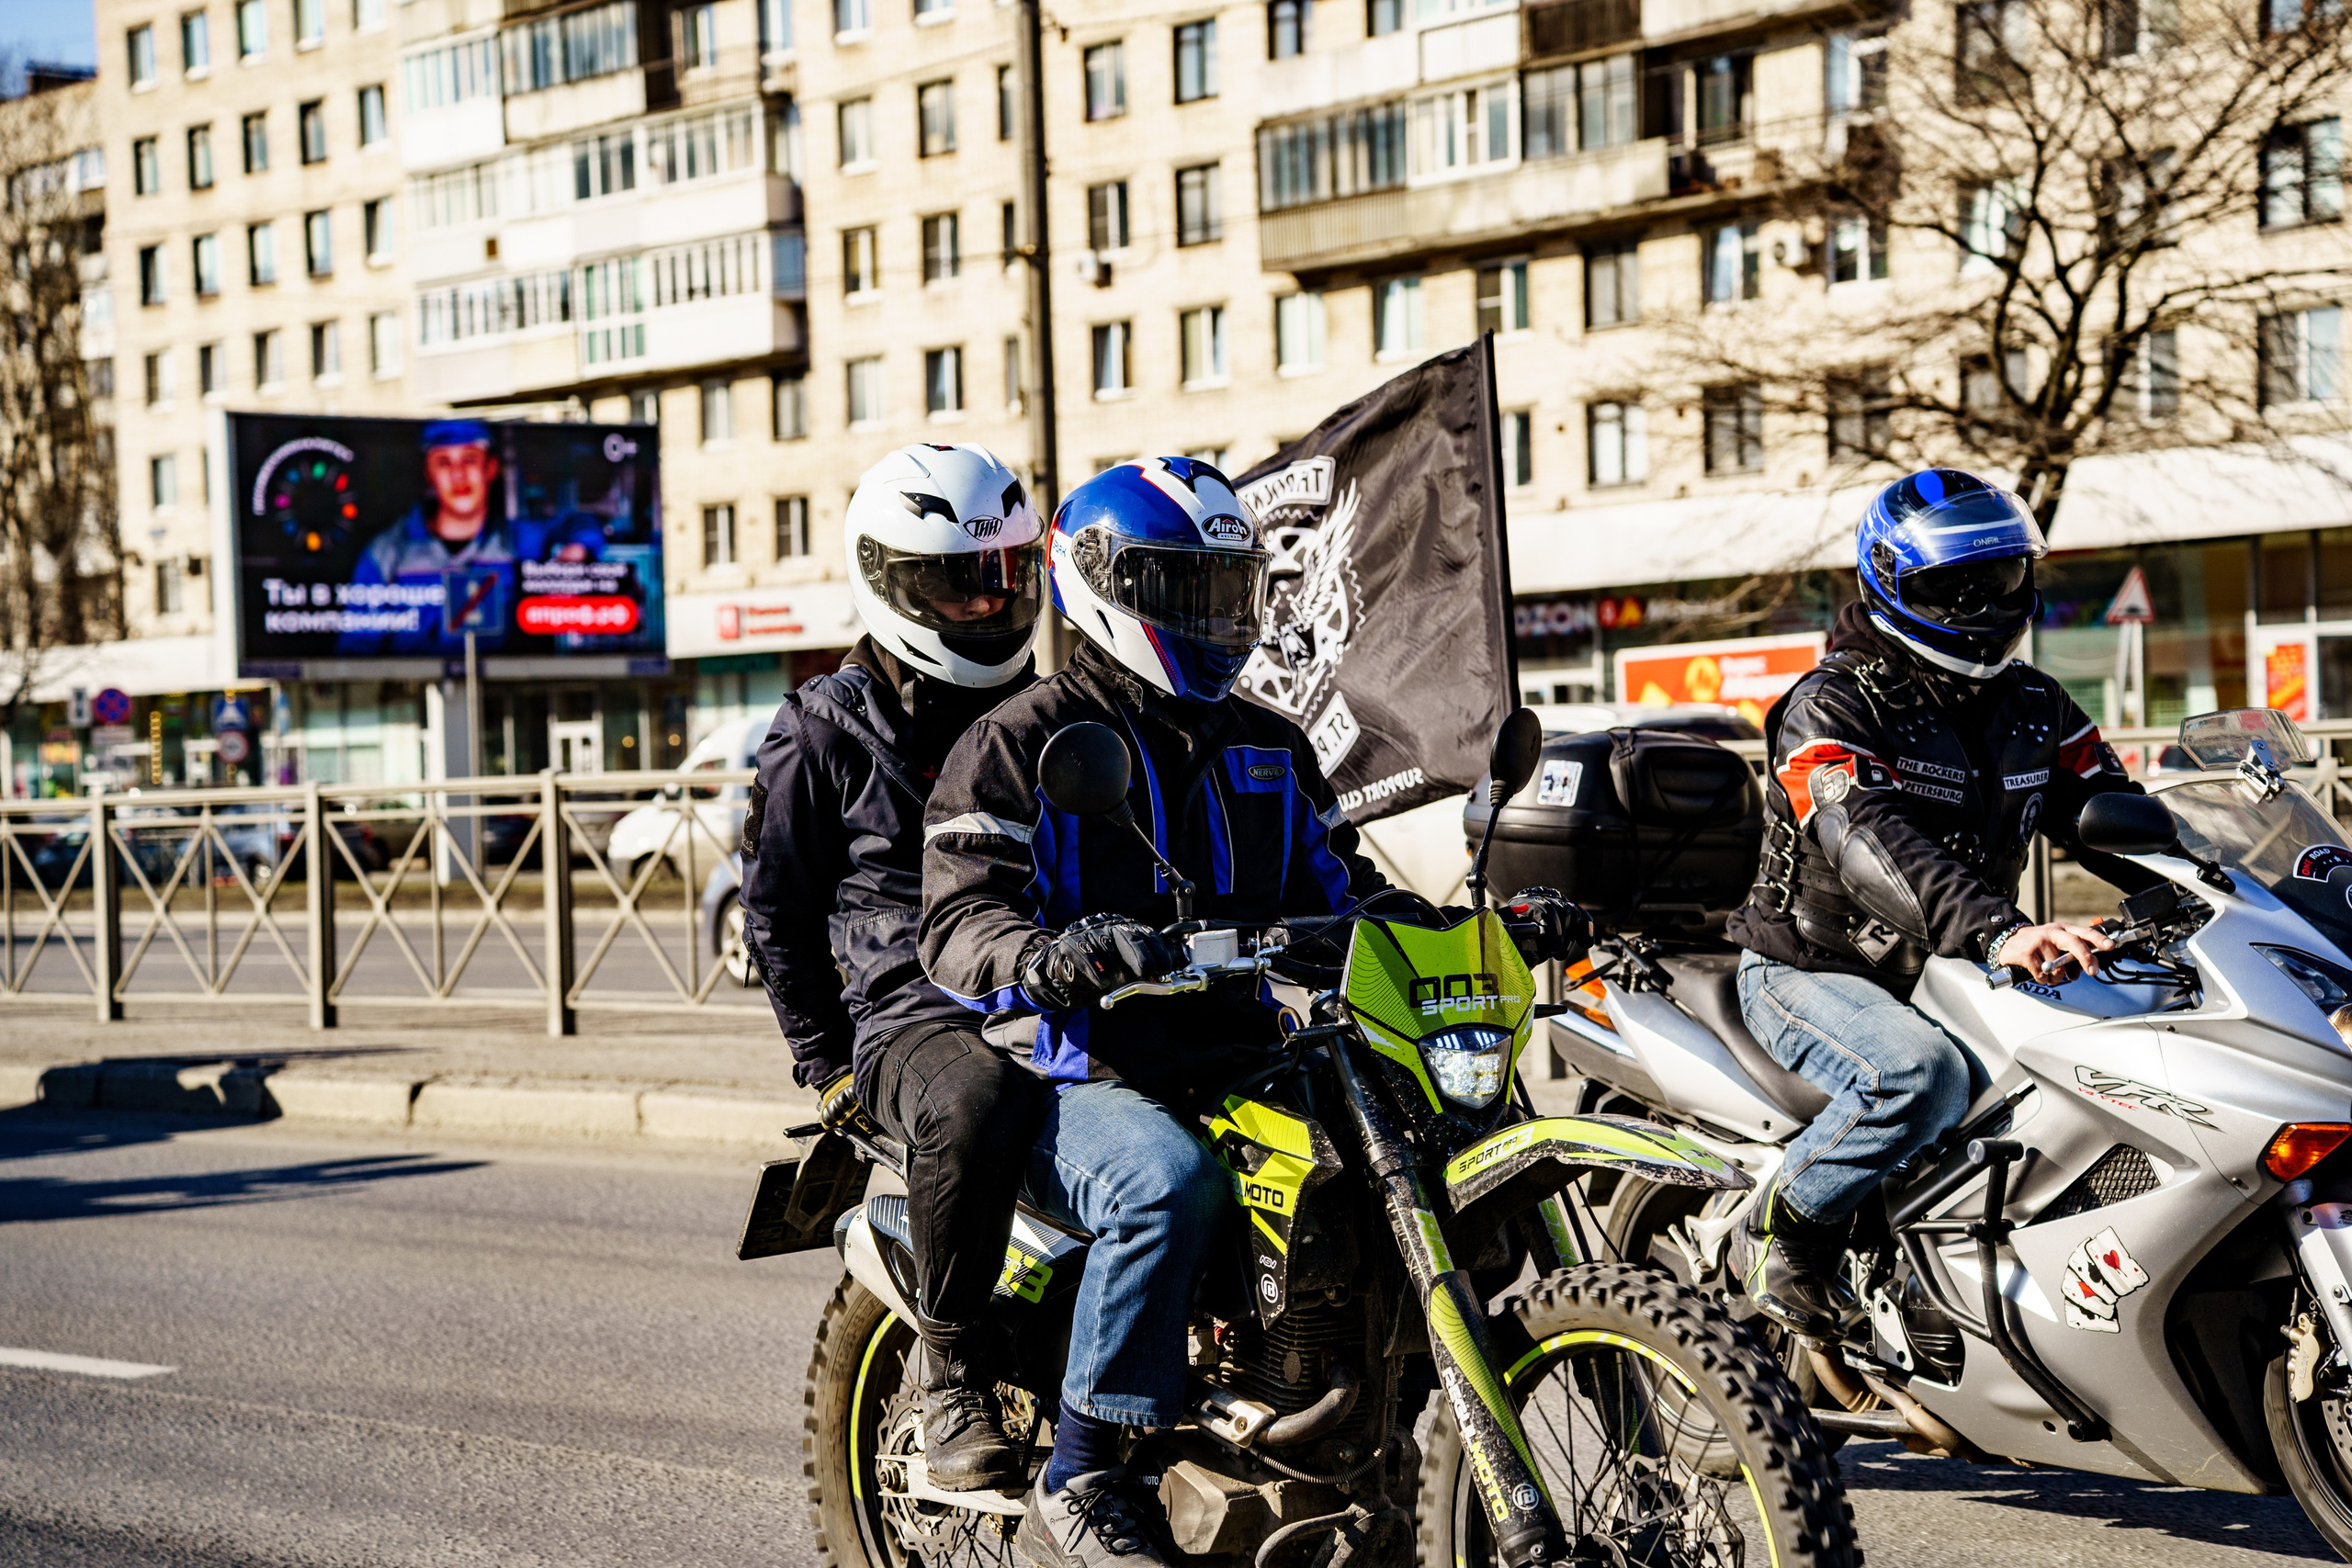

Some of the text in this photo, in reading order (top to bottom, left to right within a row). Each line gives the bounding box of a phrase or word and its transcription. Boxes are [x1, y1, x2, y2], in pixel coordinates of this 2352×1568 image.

[1207, 517, 1248, 535] Airoh
[263, 578, 447, 613] Ты в хороше
[265, 608, 420, 633] компании!
[1253, 768, 1280, 776] NERVE
[1898, 759, 1964, 782] THE ROCKERS
[2005, 772, 2049, 788] TREASURER
[1904, 781, 1962, 802] PETERSBURG
[2301, 858, 2313, 876] ONE
[2309, 848, 2331, 860] ROAD
[1869, 925, 1894, 946] R
[1409, 974, 1499, 1009] 003
[2016, 982, 2063, 1001] NDA
[1421, 995, 1521, 1016] SPORT PRO
[1459, 1144, 1502, 1174] SPORT
